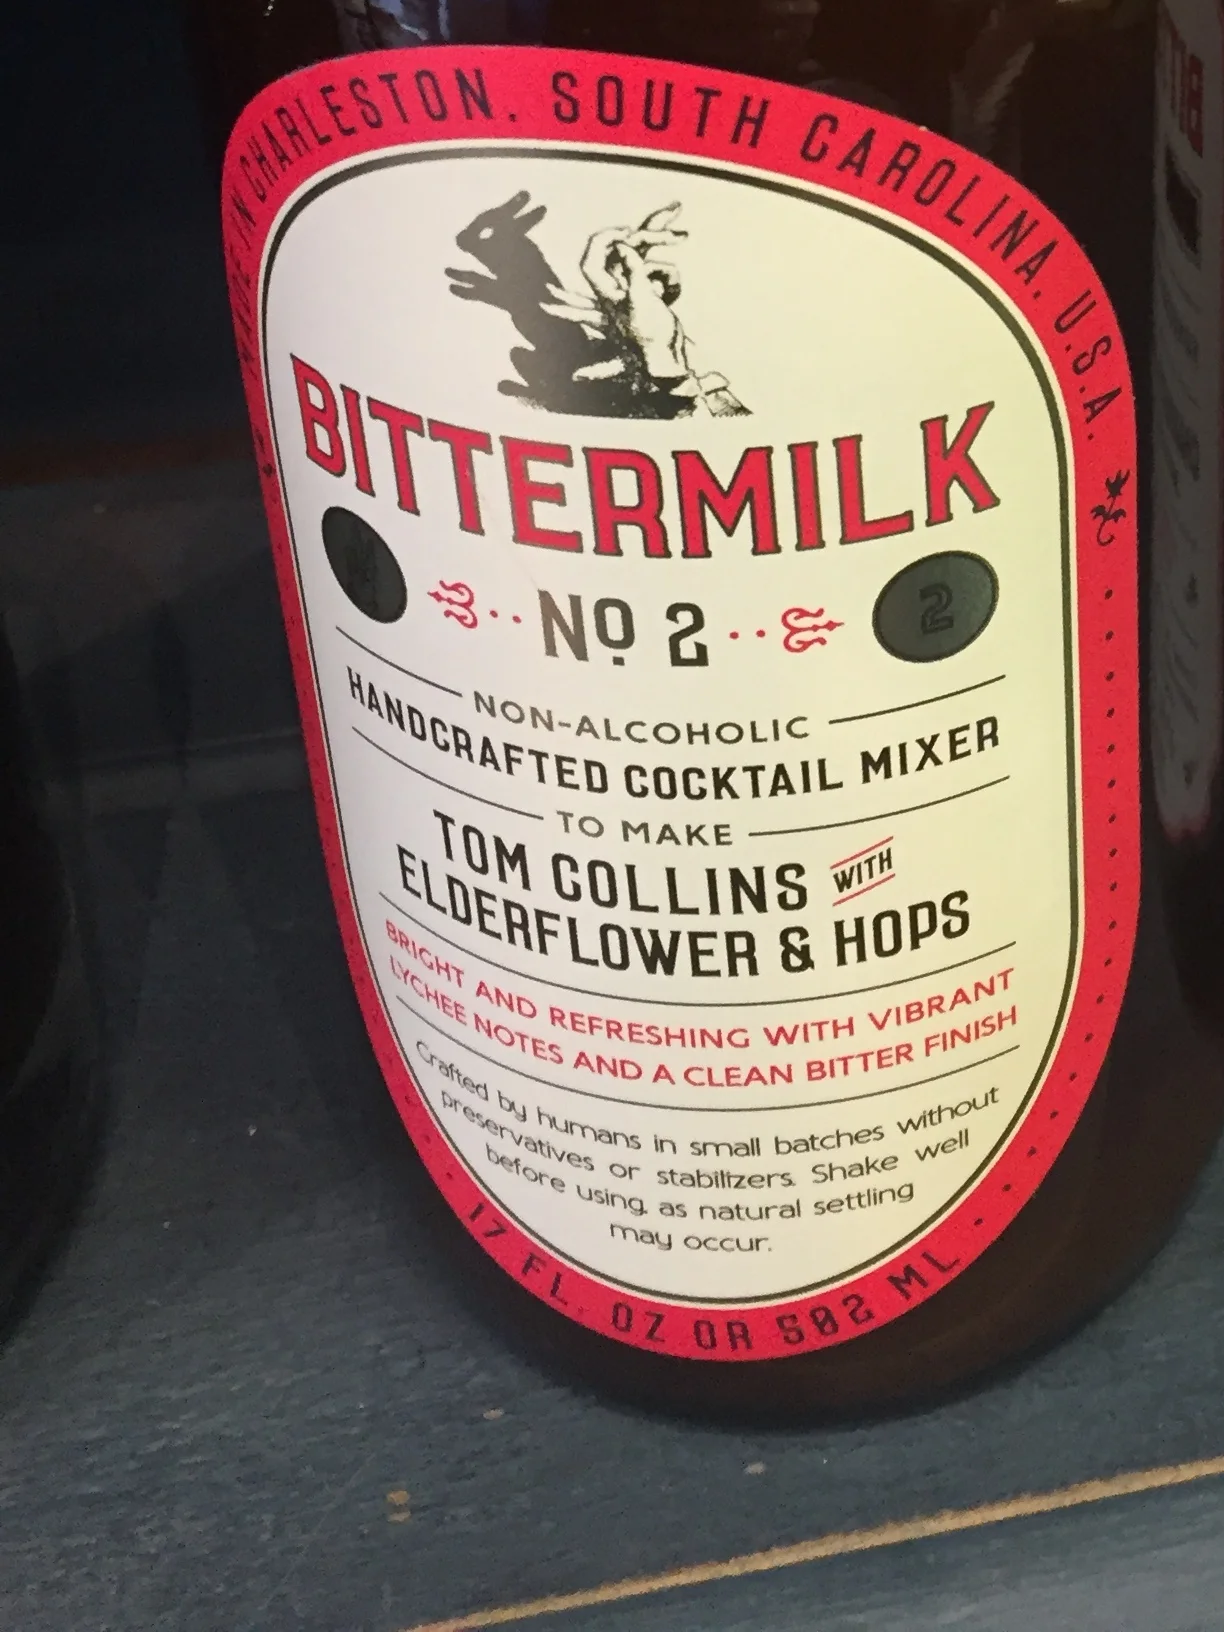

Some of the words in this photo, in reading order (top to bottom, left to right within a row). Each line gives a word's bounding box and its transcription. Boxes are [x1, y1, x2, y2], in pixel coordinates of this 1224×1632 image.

[551, 70, 771, 149] SOUTH
[290, 352, 1001, 559] BITTERMILK
[665, 602, 710, 667] 2
[918, 581, 955, 636] 2
[346, 665, 609, 795] HANDCRAFTED
[624, 758, 843, 801] COCKTAIL
[860, 715, 1000, 785] MIXER
[473, 689, 810, 745] NON-ALCOHOLIC
[433, 808, 532, 892] TOM
[551, 852, 808, 916] COLLINS
[833, 846, 894, 894] WITH
[556, 809, 605, 839] TO
[621, 819, 733, 846] MAKE
[396, 842, 760, 978] ELDERFLOWER
[779, 925, 815, 974] &
[833, 889, 971, 968] HOPS
[385, 918, 465, 989] BRIGHT
[475, 979, 538, 1020] AND
[548, 1004, 751, 1049] REFRESHING
[763, 1016, 856, 1047] WITH
[867, 967, 1016, 1032] VIBRANT
[389, 954, 468, 1027] LYCHEE
[473, 1013, 565, 1066] NOTES
[573, 1050, 644, 1082] AND
[652, 1063, 676, 1087] A
[682, 1062, 794, 1089] CLEAN
[806, 1041, 914, 1083] BITTER
[924, 1004, 1018, 1058] FINISH
[415, 1039, 490, 1103] Crafted
[497, 1089, 528, 1124] by
[537, 1106, 643, 1151] humans
[654, 1133, 677, 1156] in
[690, 1137, 761, 1157] small
[774, 1124, 885, 1156] batches
[896, 1086, 1000, 1136] without
[440, 1089, 596, 1172] preservatives
[609, 1161, 642, 1181] or
[810, 1154, 900, 1185] Shake
[914, 1127, 970, 1162] well
[484, 1141, 567, 1194] before
[658, 1200, 688, 1220] as
[699, 1198, 802, 1221] natural
[813, 1181, 916, 1216] settling
[468, 1201, 507, 1240] 17
[610, 1301, 667, 1344] OZ
[692, 1319, 753, 1352] OR
[775, 1293, 876, 1346] 502
[886, 1250, 961, 1302] ML
[609, 1221, 673, 1252] may
[683, 1235, 774, 1253] occur.
